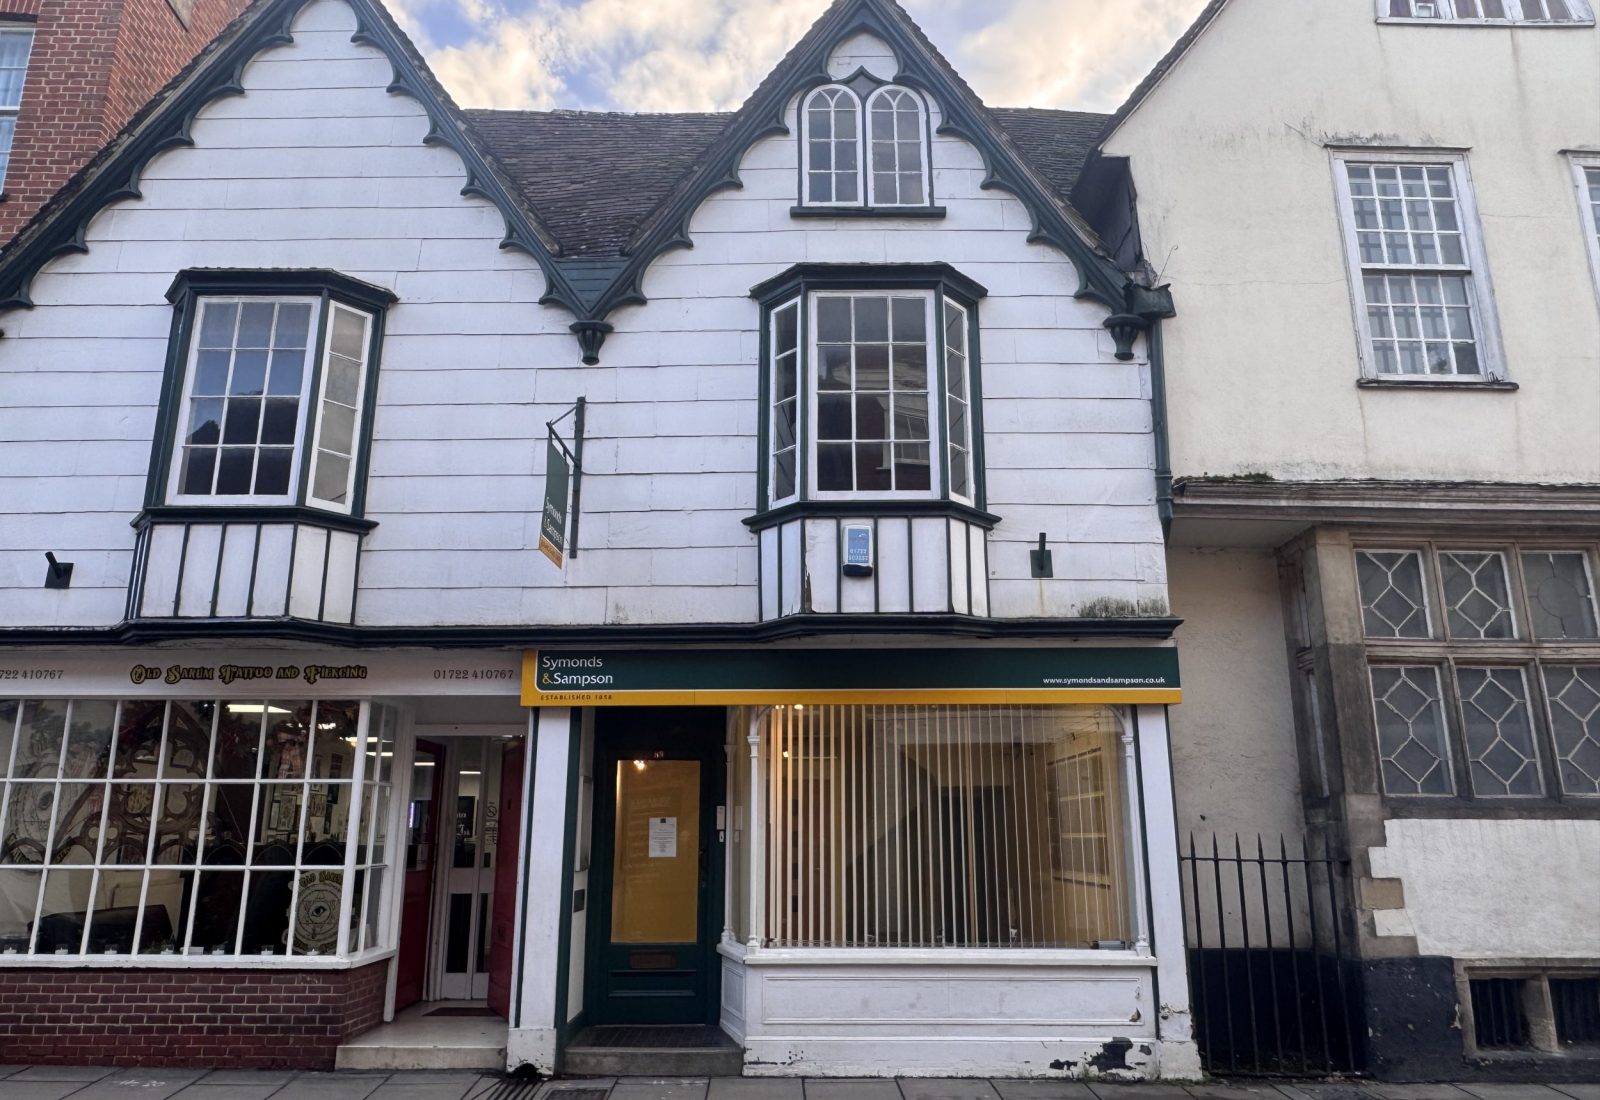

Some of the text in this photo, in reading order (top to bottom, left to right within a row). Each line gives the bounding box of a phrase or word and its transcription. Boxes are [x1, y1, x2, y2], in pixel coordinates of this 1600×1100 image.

[542, 656, 603, 670] Symonds
[21, 669, 65, 680] 410767
[433, 669, 514, 680] 01722 410767
[1042, 676, 1166, 685] www.symondsandsampson.co.uk
